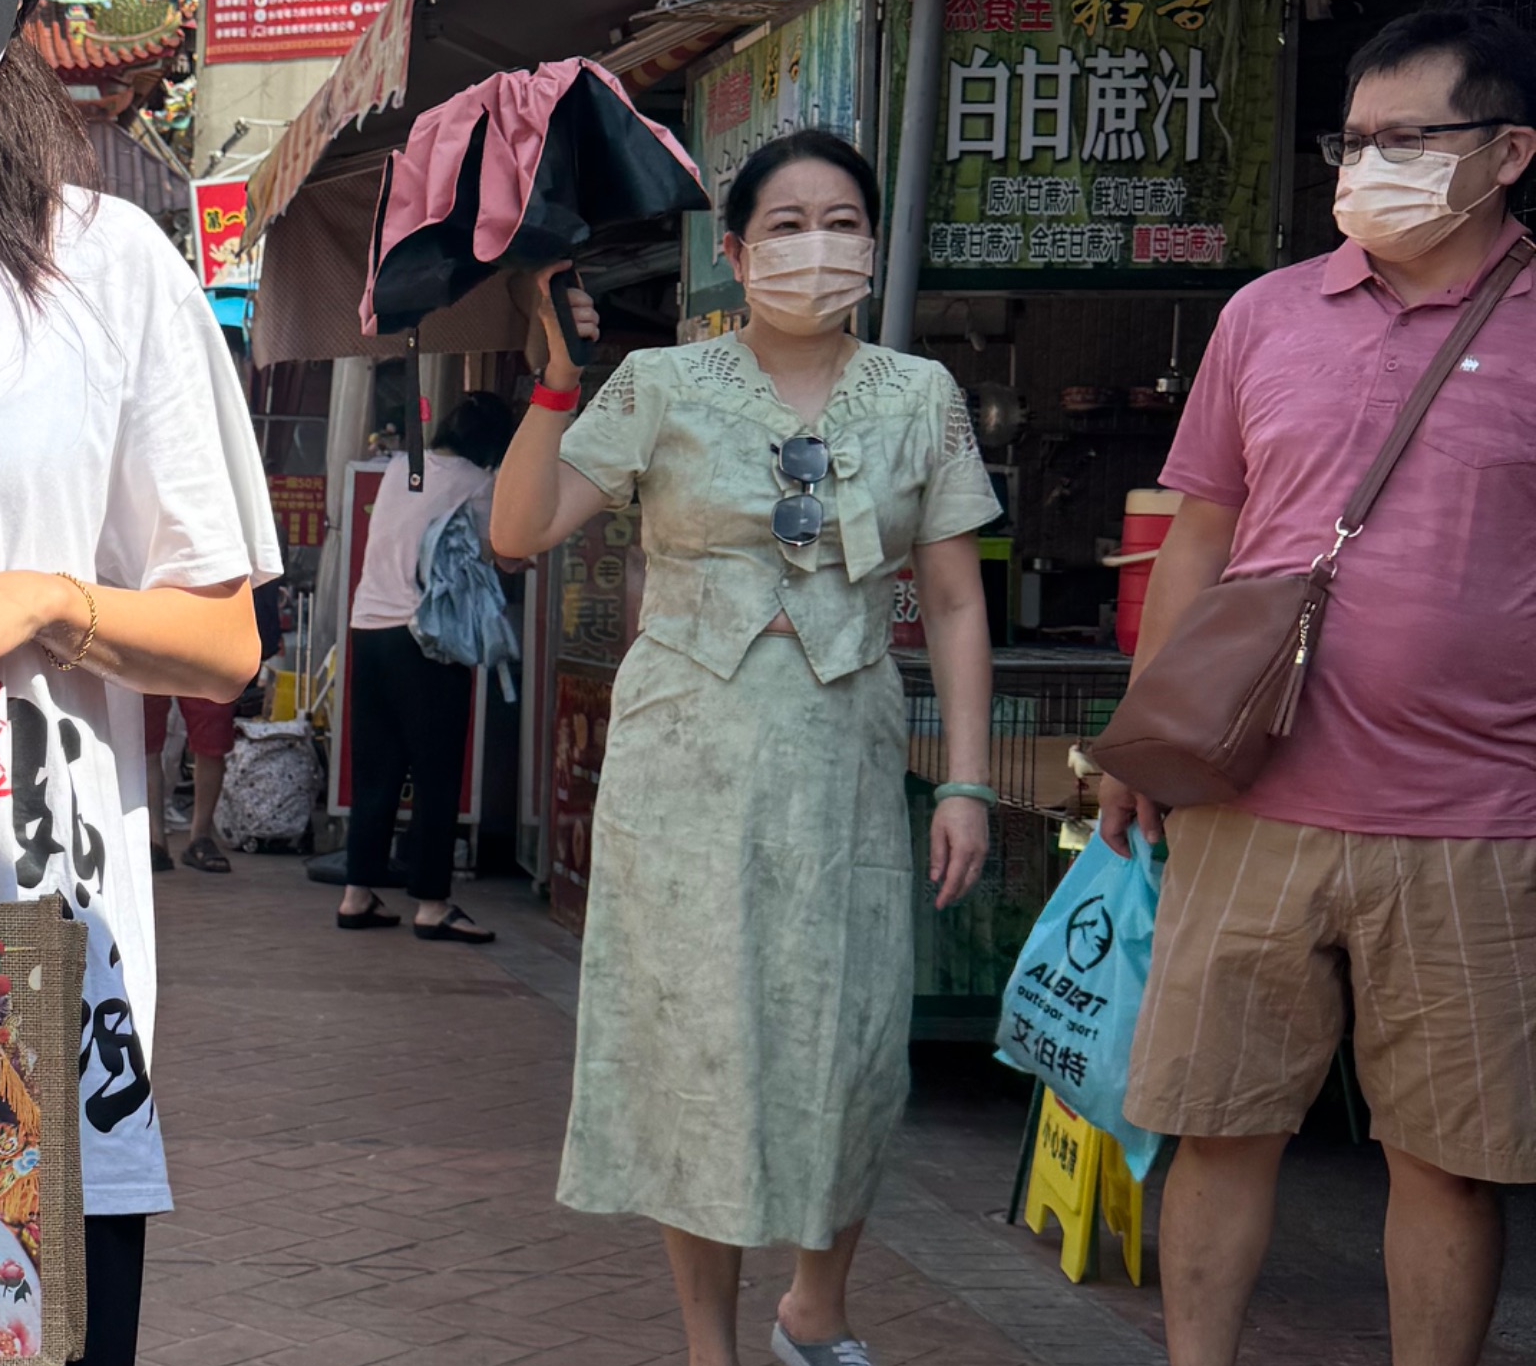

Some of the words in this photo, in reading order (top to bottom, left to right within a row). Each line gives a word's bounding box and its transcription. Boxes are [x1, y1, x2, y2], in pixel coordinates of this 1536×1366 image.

[946, 44, 1217, 163] 白甘蔗汁
[987, 176, 1081, 216] 原汁甘蔗汁
[1092, 176, 1186, 216] 鮮奶甘蔗汁
[1029, 223, 1124, 263] 金桔甘蔗汁
[1132, 223, 1227, 263] 薑母甘蔗汁
[1025, 962, 1109, 1017] ALBERT
[1010, 1011, 1088, 1087] 艾伯特
